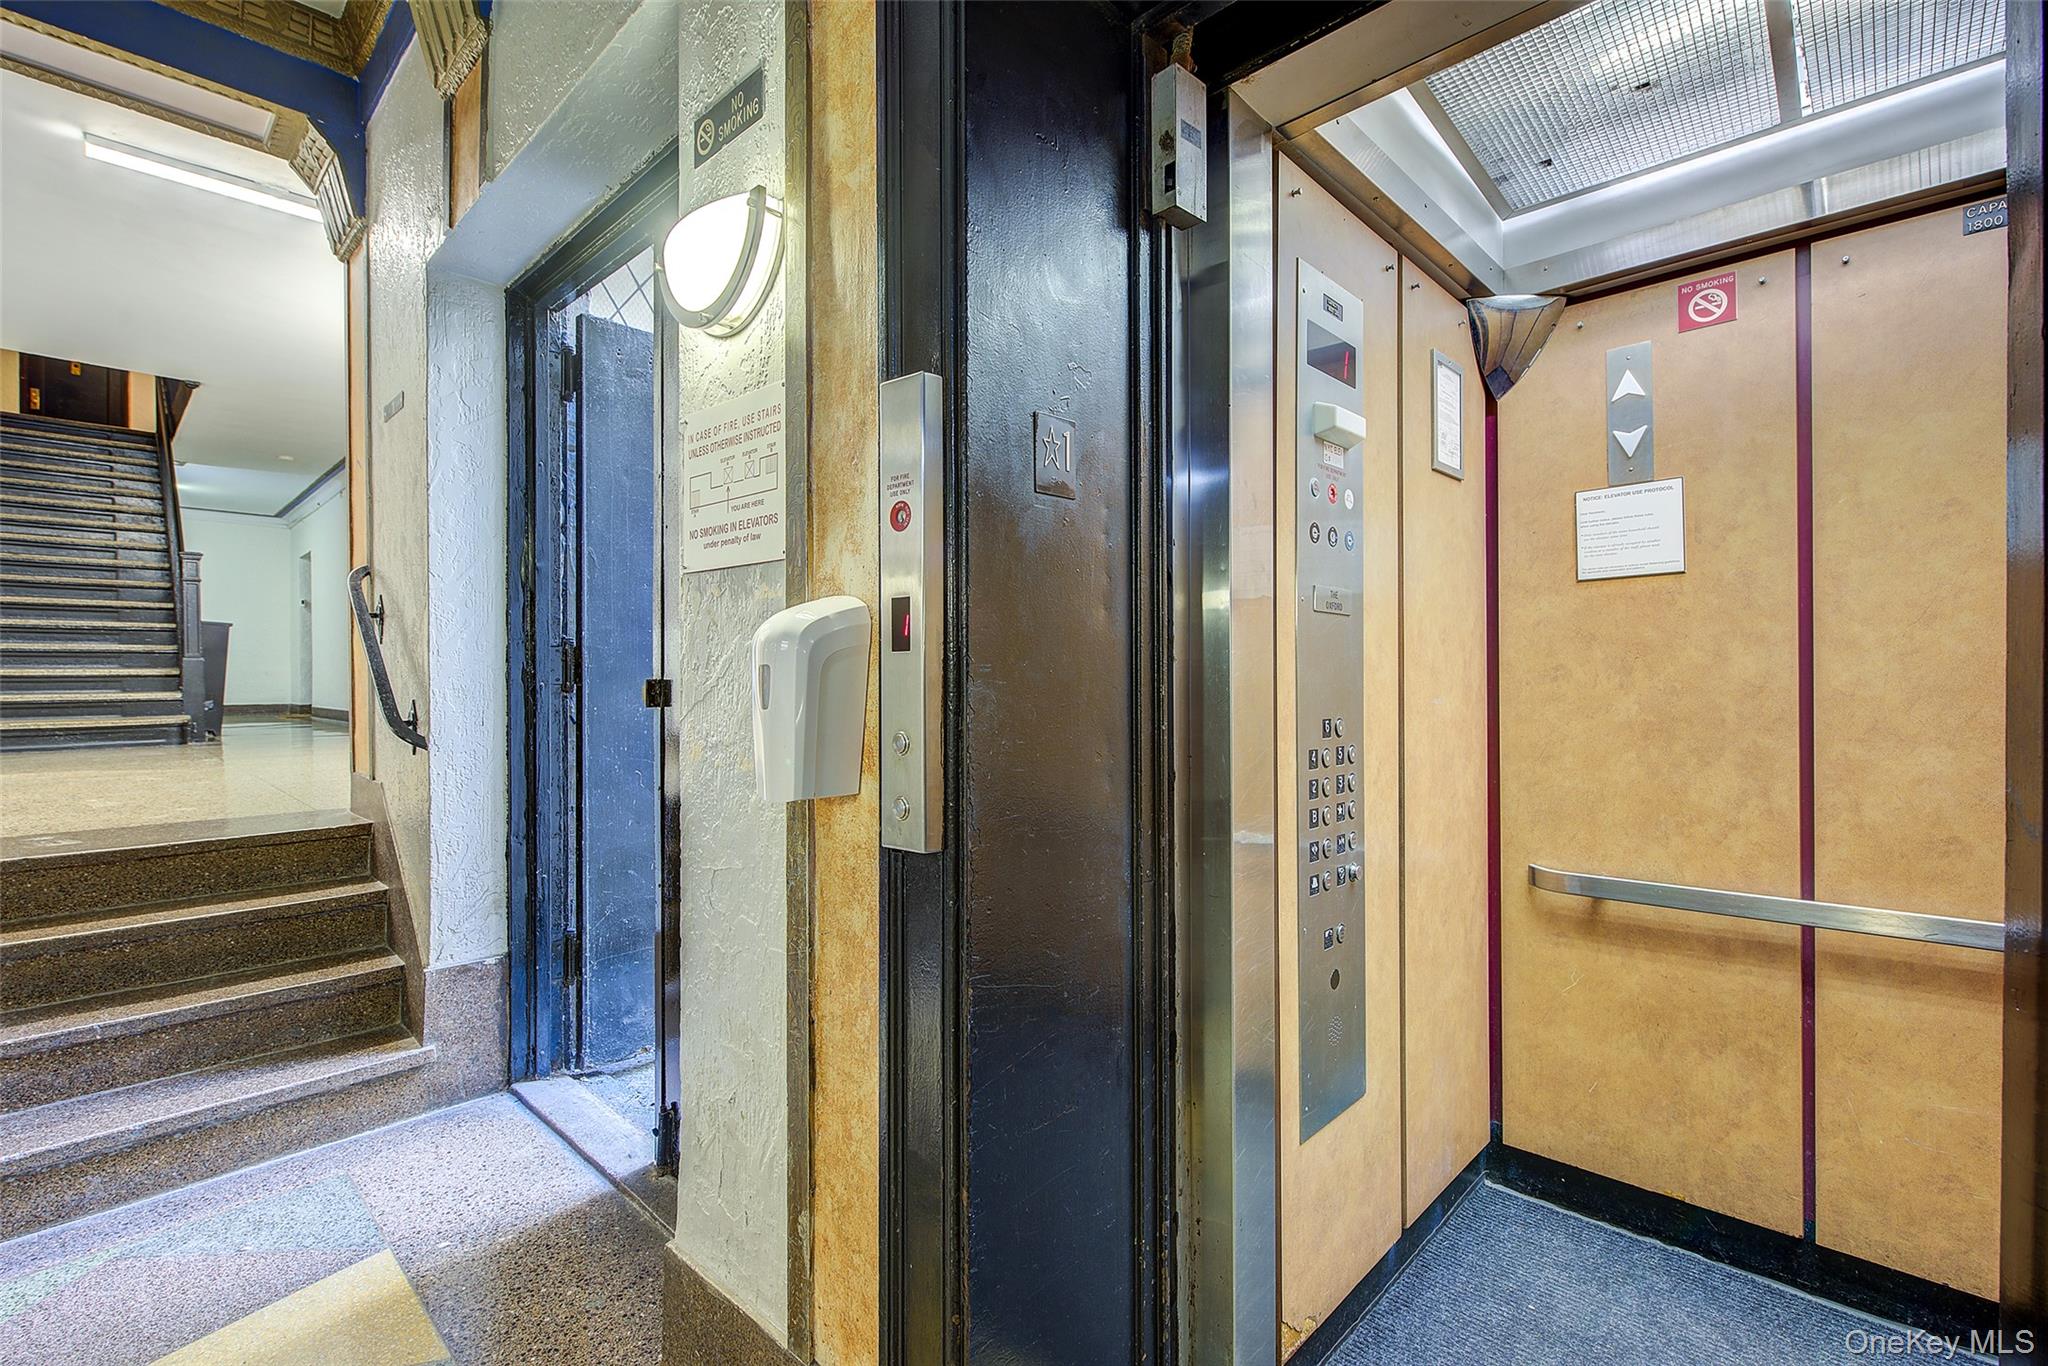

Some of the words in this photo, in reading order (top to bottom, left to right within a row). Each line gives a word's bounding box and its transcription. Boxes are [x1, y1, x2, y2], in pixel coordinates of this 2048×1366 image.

[731, 91, 744, 112] NO
[718, 98, 759, 141] SMOKING
[1966, 200, 2007, 218] CAPA
[1968, 215, 2003, 232] 1800
[1681, 286, 1693, 294] NO
[1695, 275, 1734, 290] SMOKING
[1343, 351, 1350, 380] 1
[688, 435, 694, 445] IN
[696, 428, 711, 442] CASE
[713, 424, 721, 436] OF
[742, 413, 755, 427] USE
[757, 404, 781, 422] STAIRS
[688, 444, 709, 460] UNLESS
[710, 433, 742, 453] OTHERWISE
[743, 421, 781, 443] INSTRUCTED
[1062, 431, 1070, 473] 1
[887, 480, 914, 490] DEPARTMENT
[1604, 491, 1631, 500] ELEVATOR
[1644, 485, 1674, 494] PROTOCOL
[730, 503, 740, 512] YOU
[741, 501, 750, 509] ARE
[751, 499, 764, 507] HERE
[689, 530, 699, 540] NO
[700, 523, 728, 538] SMOKING
[730, 520, 737, 532] IN
[739, 513, 778, 531] ELEVATORS
[703, 539, 719, 550] under
[721, 534, 742, 548] penalty
[743, 532, 749, 542] of
[750, 532, 761, 541] law
[904, 614, 909, 636] 1
